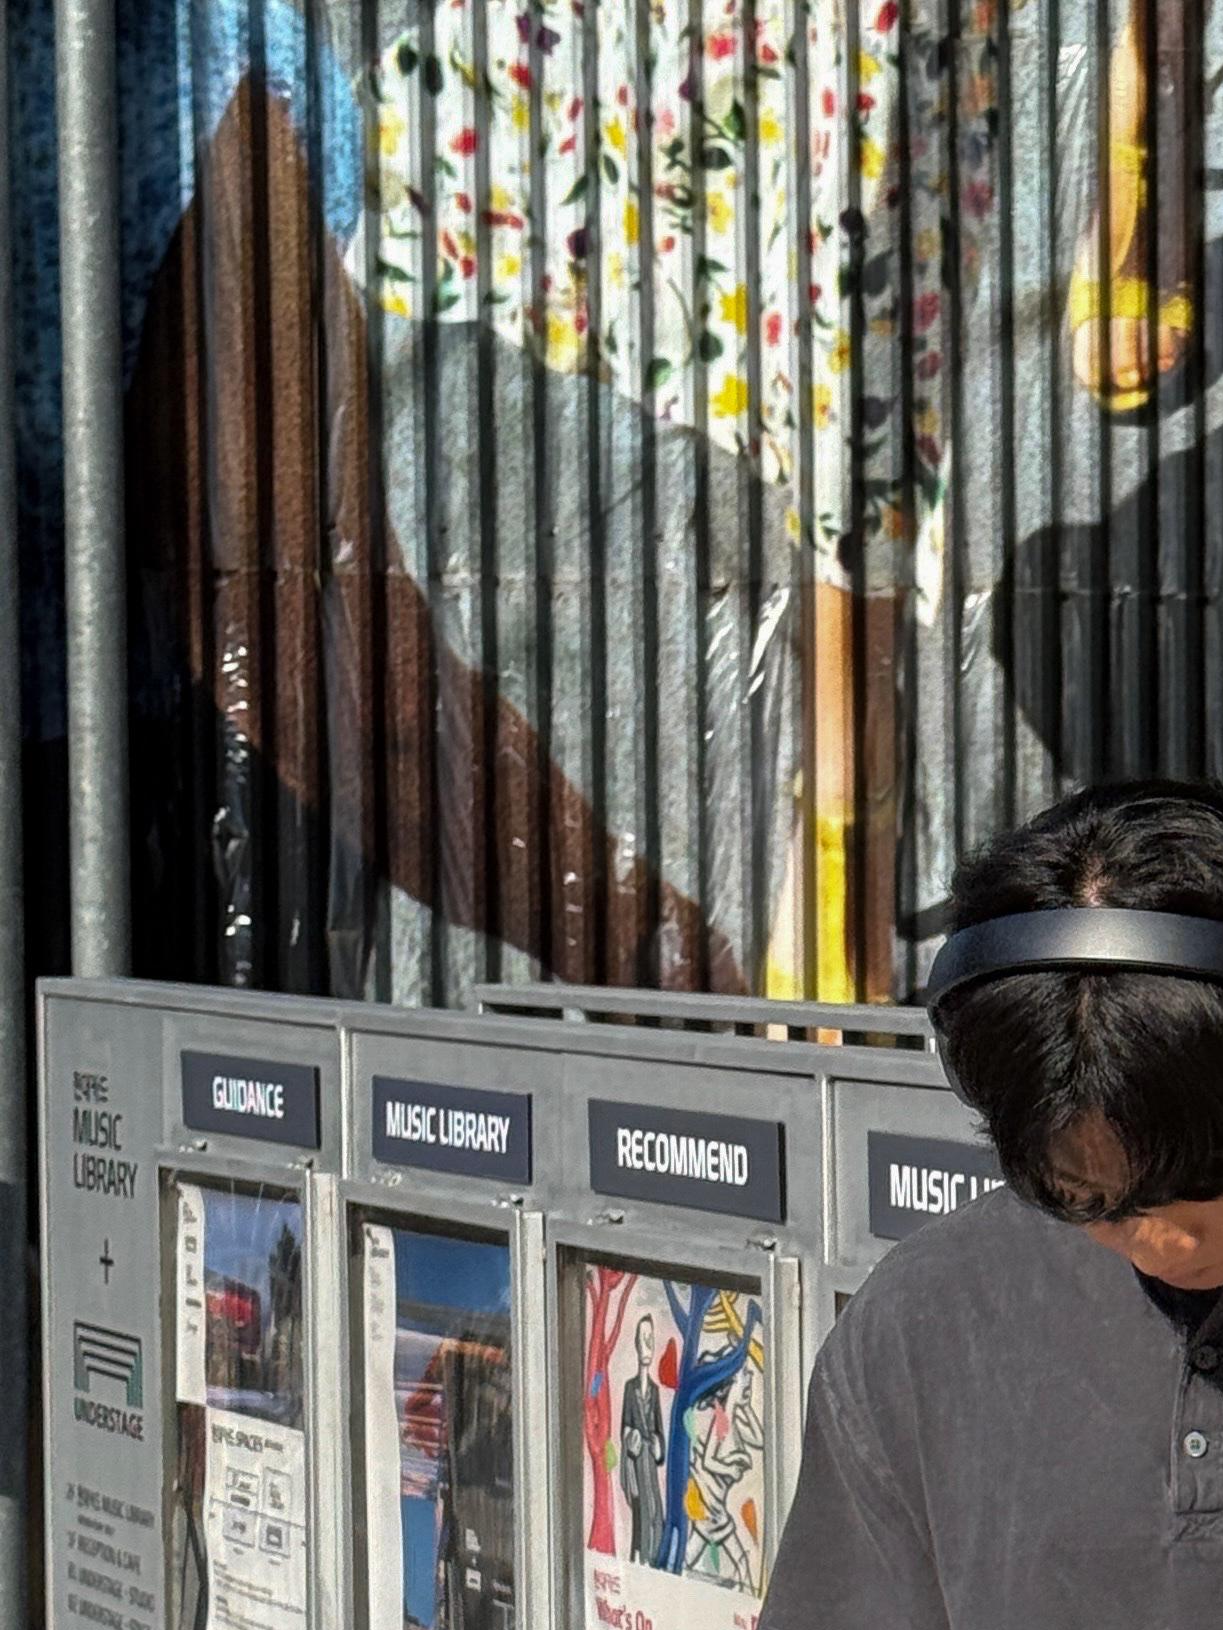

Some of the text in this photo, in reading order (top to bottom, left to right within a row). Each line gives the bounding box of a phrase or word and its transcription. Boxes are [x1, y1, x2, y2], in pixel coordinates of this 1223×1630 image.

[212, 1076, 284, 1118] GUIDANCE
[73, 1106, 122, 1151] MUSIC
[386, 1101, 510, 1154] MUSIC LIBRARY
[74, 1153, 138, 1199] LIBRARY
[616, 1127, 749, 1186] RECOMMEND
[73, 1398, 144, 1442] UNDERSTAGE
